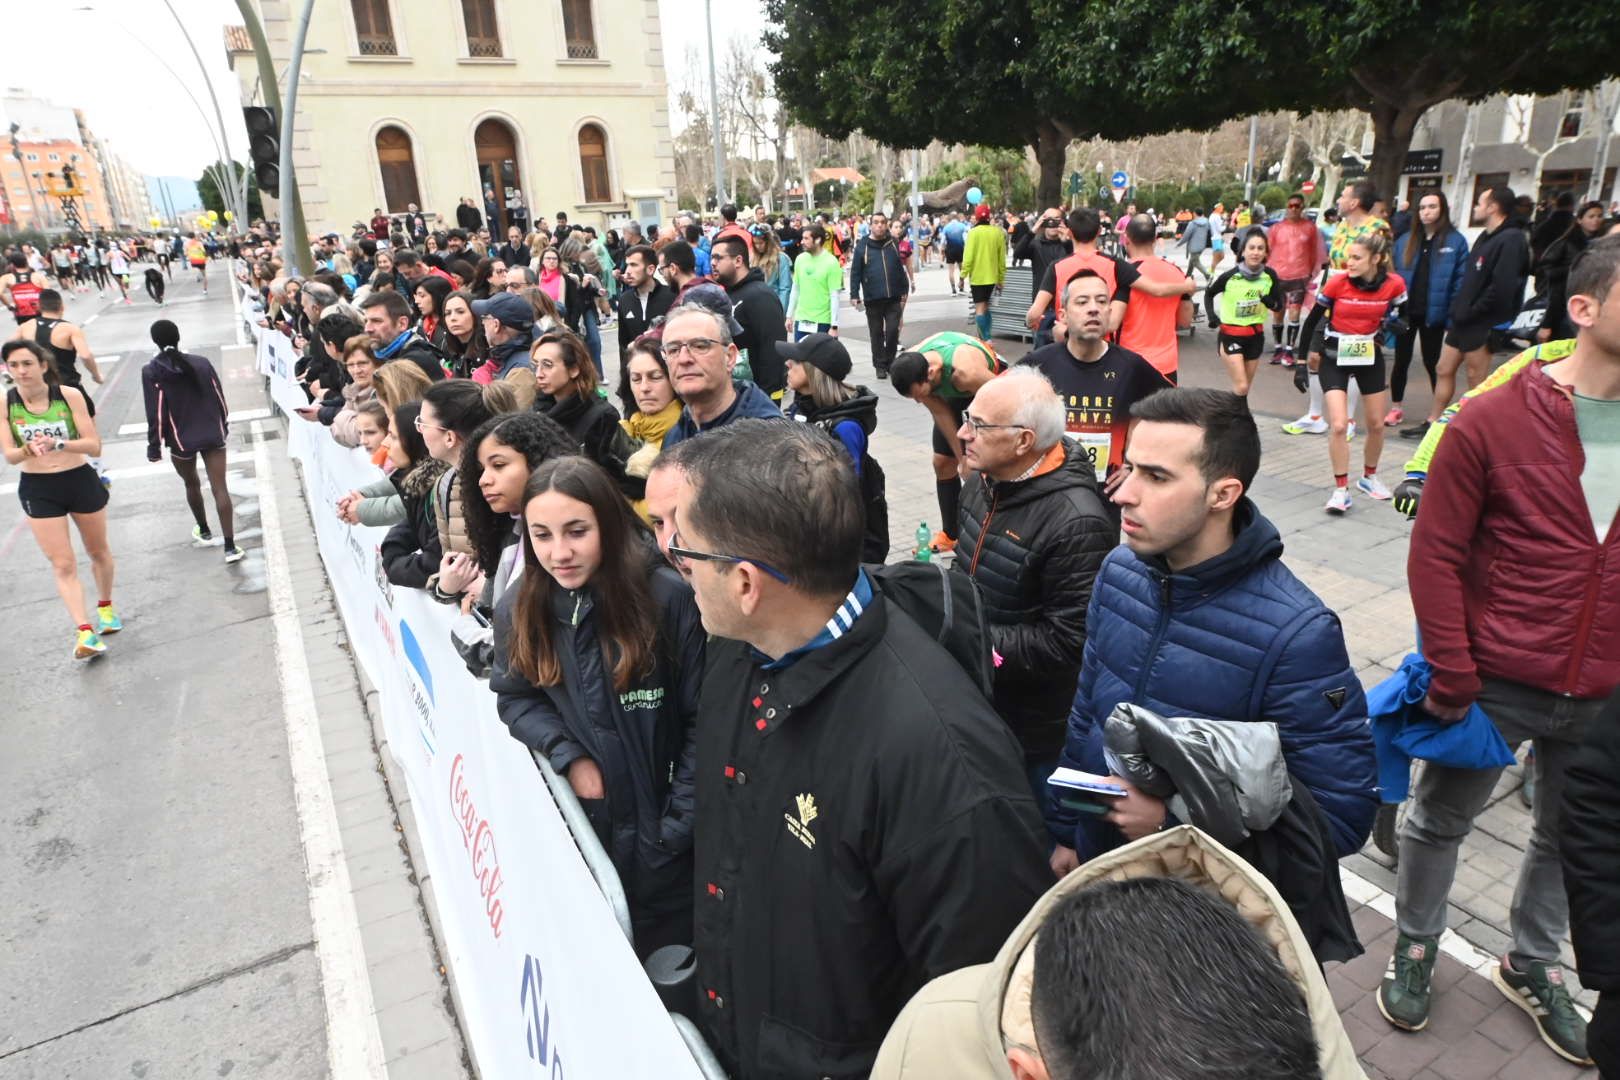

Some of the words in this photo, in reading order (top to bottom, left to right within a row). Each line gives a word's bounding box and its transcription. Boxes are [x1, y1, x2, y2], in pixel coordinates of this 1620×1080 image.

[1347, 342, 1368, 353] 735
[1069, 395, 1113, 408] ORRE
[1067, 411, 1112, 424] ANYA
[619, 687, 664, 704] PAMESA
[450, 753, 503, 938] Coca-Cola
